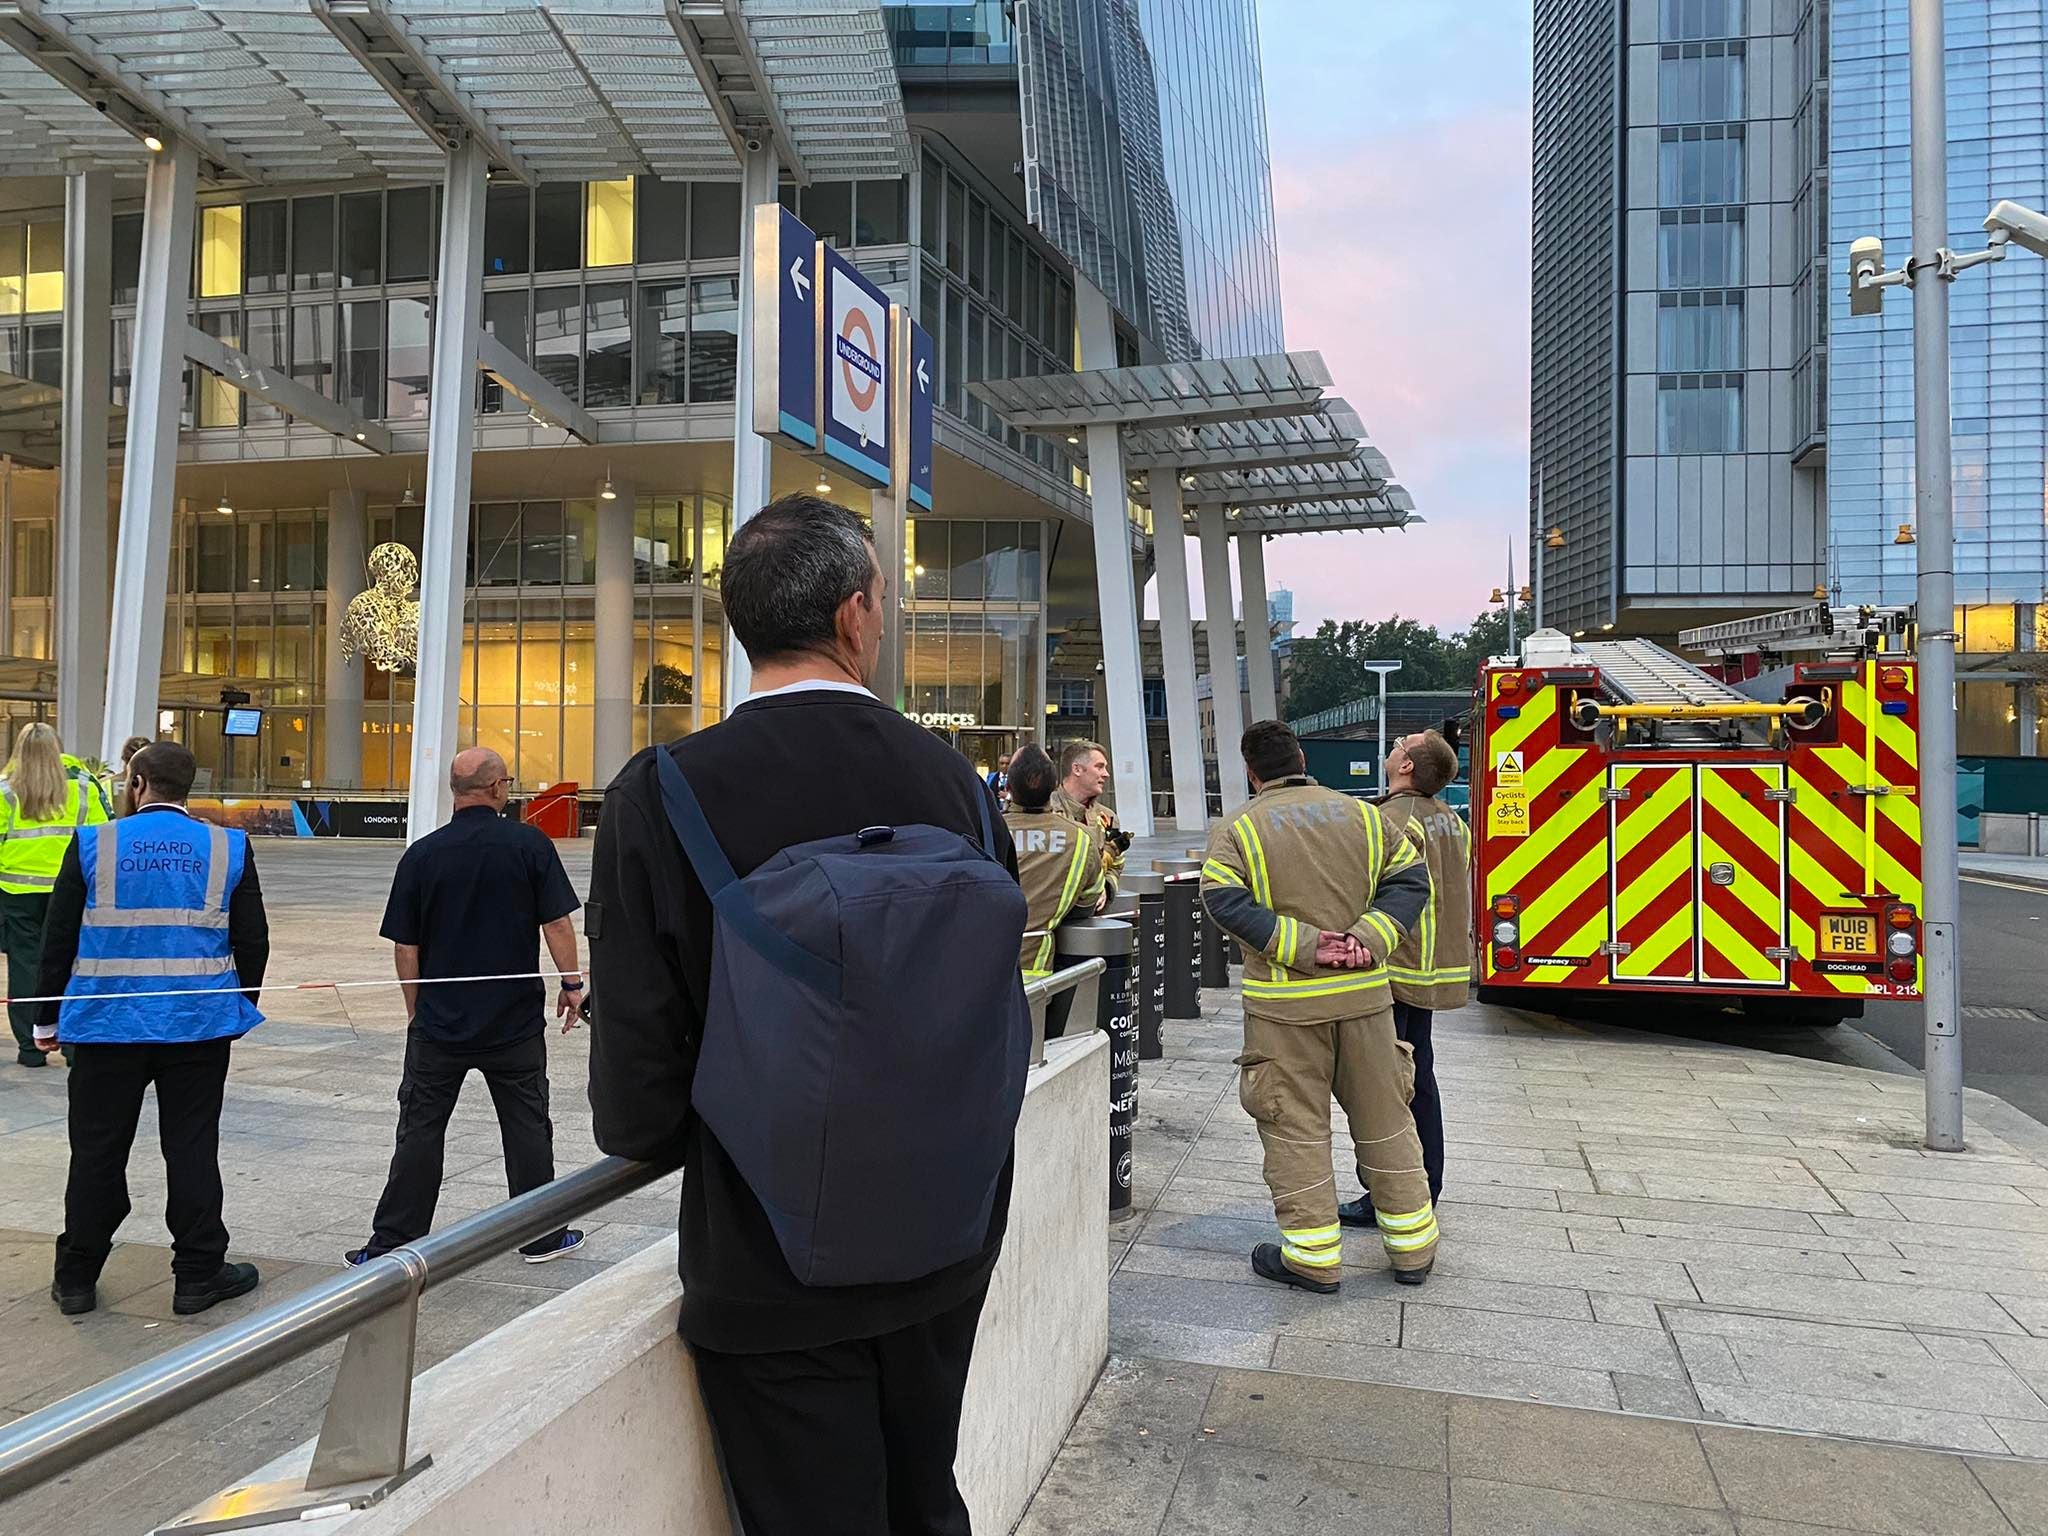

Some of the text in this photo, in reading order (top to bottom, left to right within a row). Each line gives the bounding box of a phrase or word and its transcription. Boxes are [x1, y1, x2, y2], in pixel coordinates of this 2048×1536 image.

[839, 339, 880, 379] UNDERGROUND
[922, 712, 976, 726] OFFICES
[1496, 791, 1526, 800] Cyclists
[363, 816, 398, 824] LONDON'S
[1267, 800, 1351, 832] FIRE
[132, 841, 193, 856] SHARD
[1010, 830, 1067, 853] IRE
[120, 858, 202, 874] QUARTER
[1829, 918, 1868, 934] WU18
[1832, 935, 1867, 951] FBE
[1528, 957, 1570, 966] Emergency
[1827, 964, 1867, 972] DOCKHEAD
[1896, 985, 1918, 996] 213
